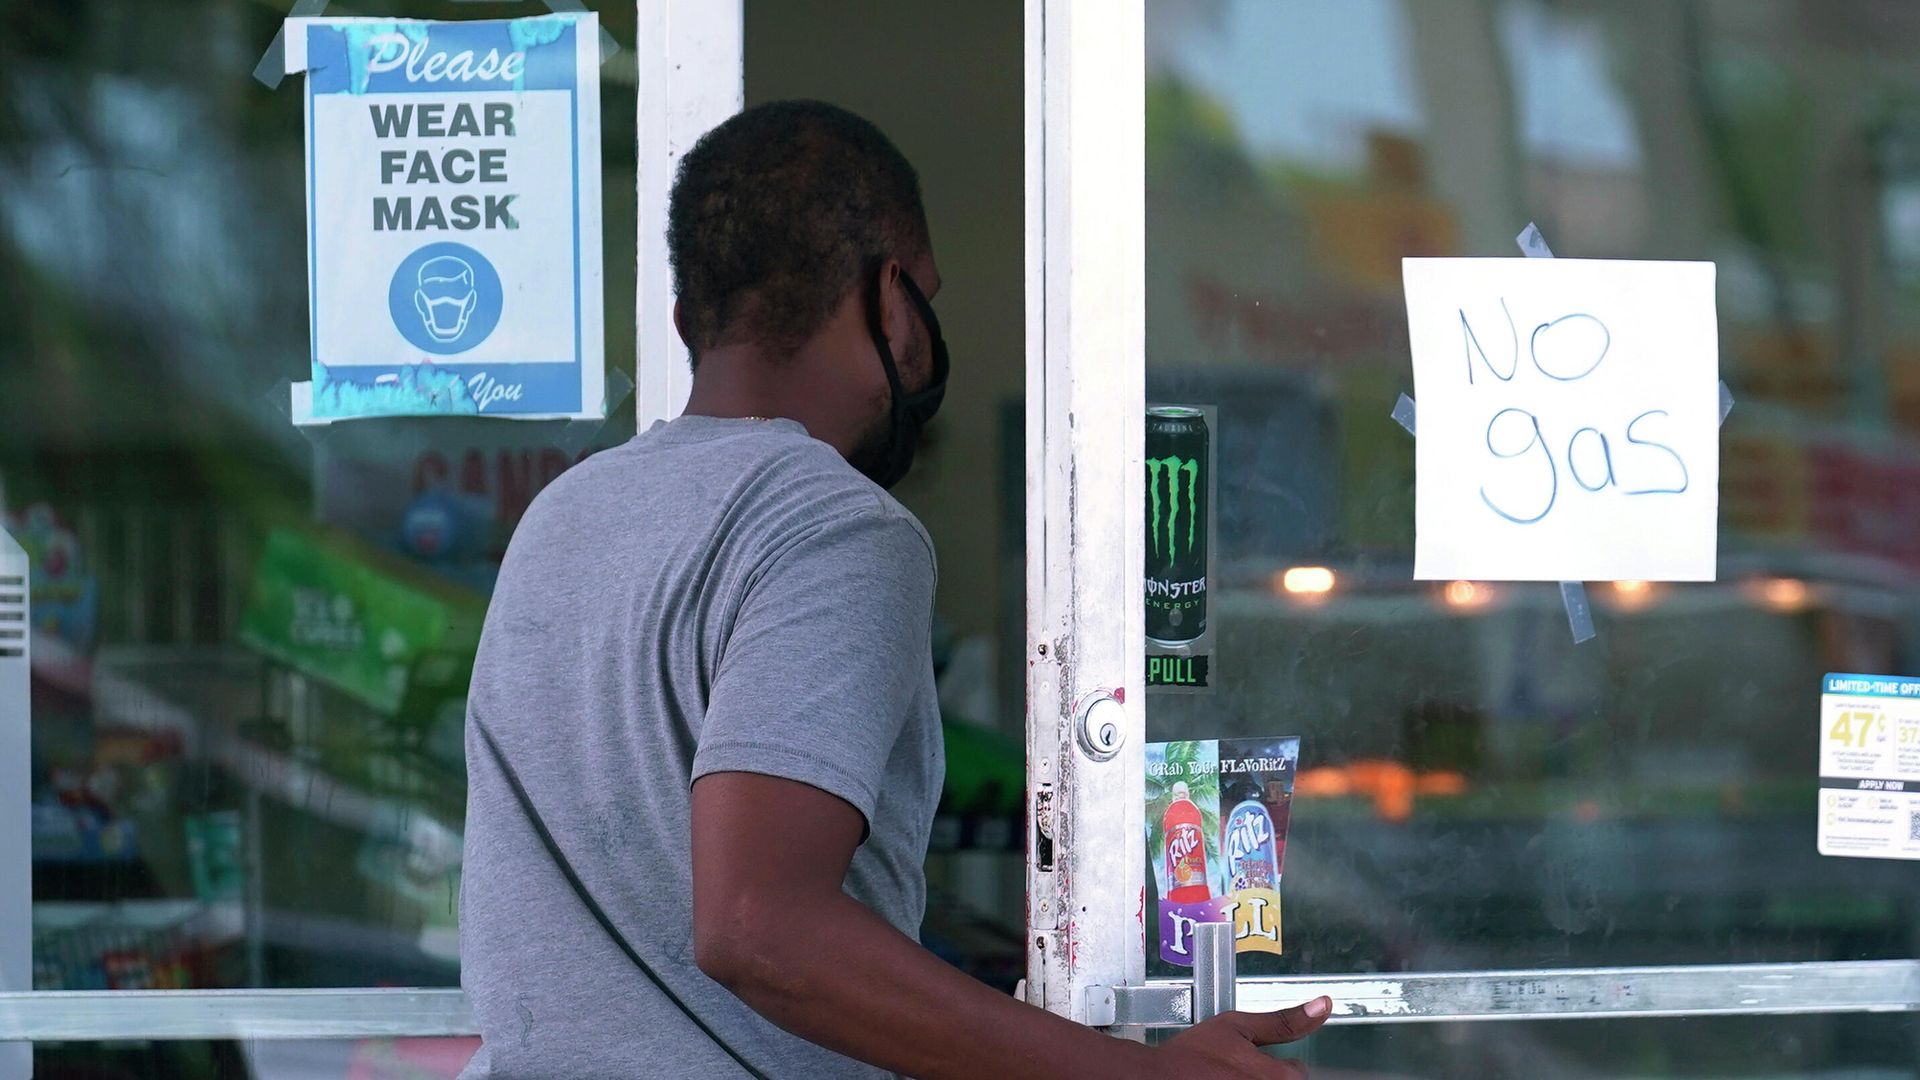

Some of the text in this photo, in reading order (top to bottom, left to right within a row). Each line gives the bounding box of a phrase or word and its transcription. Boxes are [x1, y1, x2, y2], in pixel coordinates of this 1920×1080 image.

[362, 33, 524, 83] Please
[369, 103, 516, 137] WEAR
[381, 149, 508, 184] FACE
[372, 194, 519, 231] MASK
[468, 372, 523, 411] You
[1480, 408, 1688, 525] gas
[1145, 577, 1206, 599] ONSTER
[1146, 599, 1200, 609] ENERGY
[1150, 658, 1196, 682] PULL
[1829, 679, 1899, 695] LIMITED-TIME
[1858, 779, 1904, 791] APPLY NOW
[1168, 897, 1278, 955] PLL
